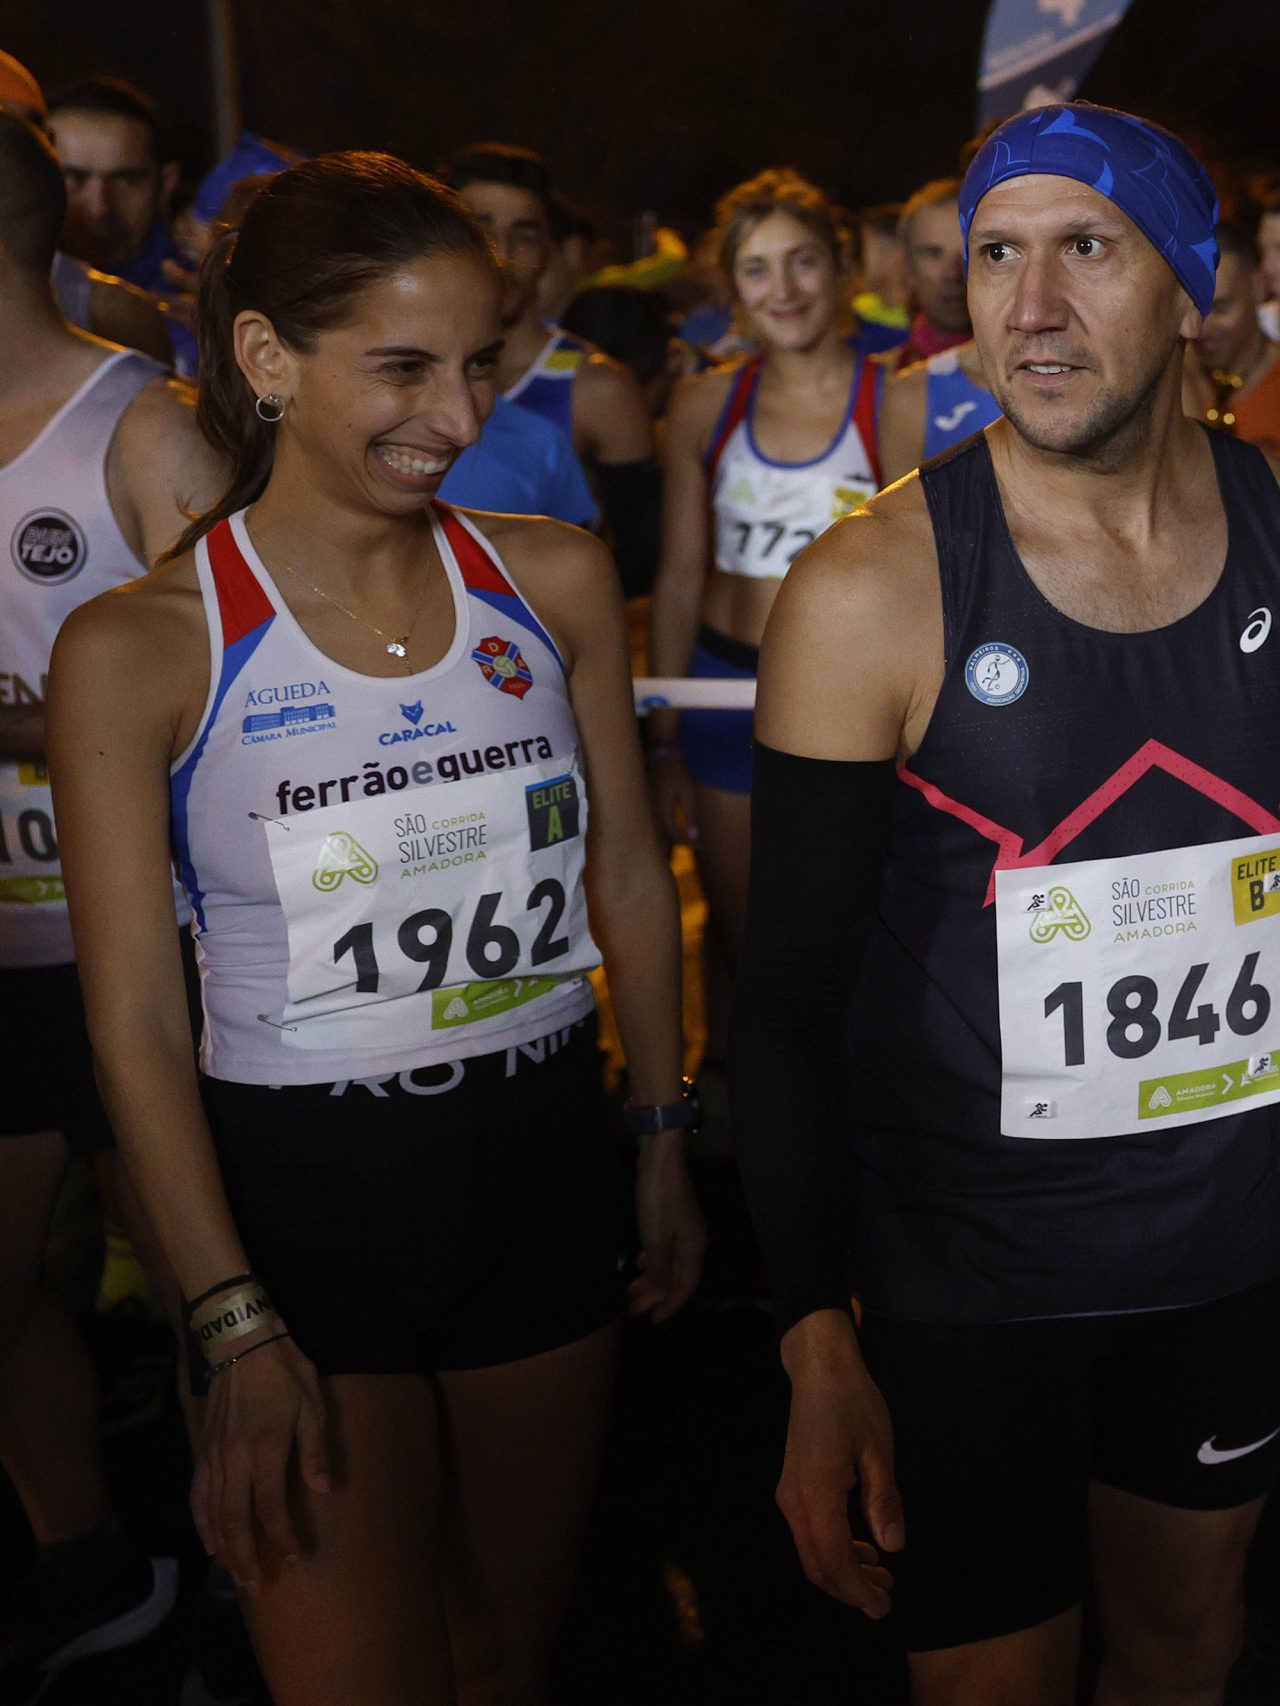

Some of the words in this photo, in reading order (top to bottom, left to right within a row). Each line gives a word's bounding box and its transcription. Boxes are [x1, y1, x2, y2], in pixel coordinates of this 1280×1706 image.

[21, 544, 74, 565] TEJO
[244, 680, 331, 708] ÁGUEDA
[378, 721, 457, 746] CARACAL
[532, 781, 571, 809] ELITE
[393, 813, 427, 838] SÃO
[431, 811, 487, 830] CORRIDA
[547, 804, 564, 843] A
[398, 824, 488, 864] SILVESTRE
[400, 850, 487, 880] AMADORA
[1237, 856, 1278, 881] ELITE
[1111, 877, 1141, 901] SÃO
[1144, 881, 1196, 896] CORRIDA
[1249, 879, 1265, 913] B
[1112, 893, 1197, 927] SILVESTRE
[333, 878, 570, 993] 1962
[1113, 921, 1198, 943] AMADORA
[1044, 951, 1271, 1067] 1846
[1175, 1083, 1217, 1096] AMADORA
